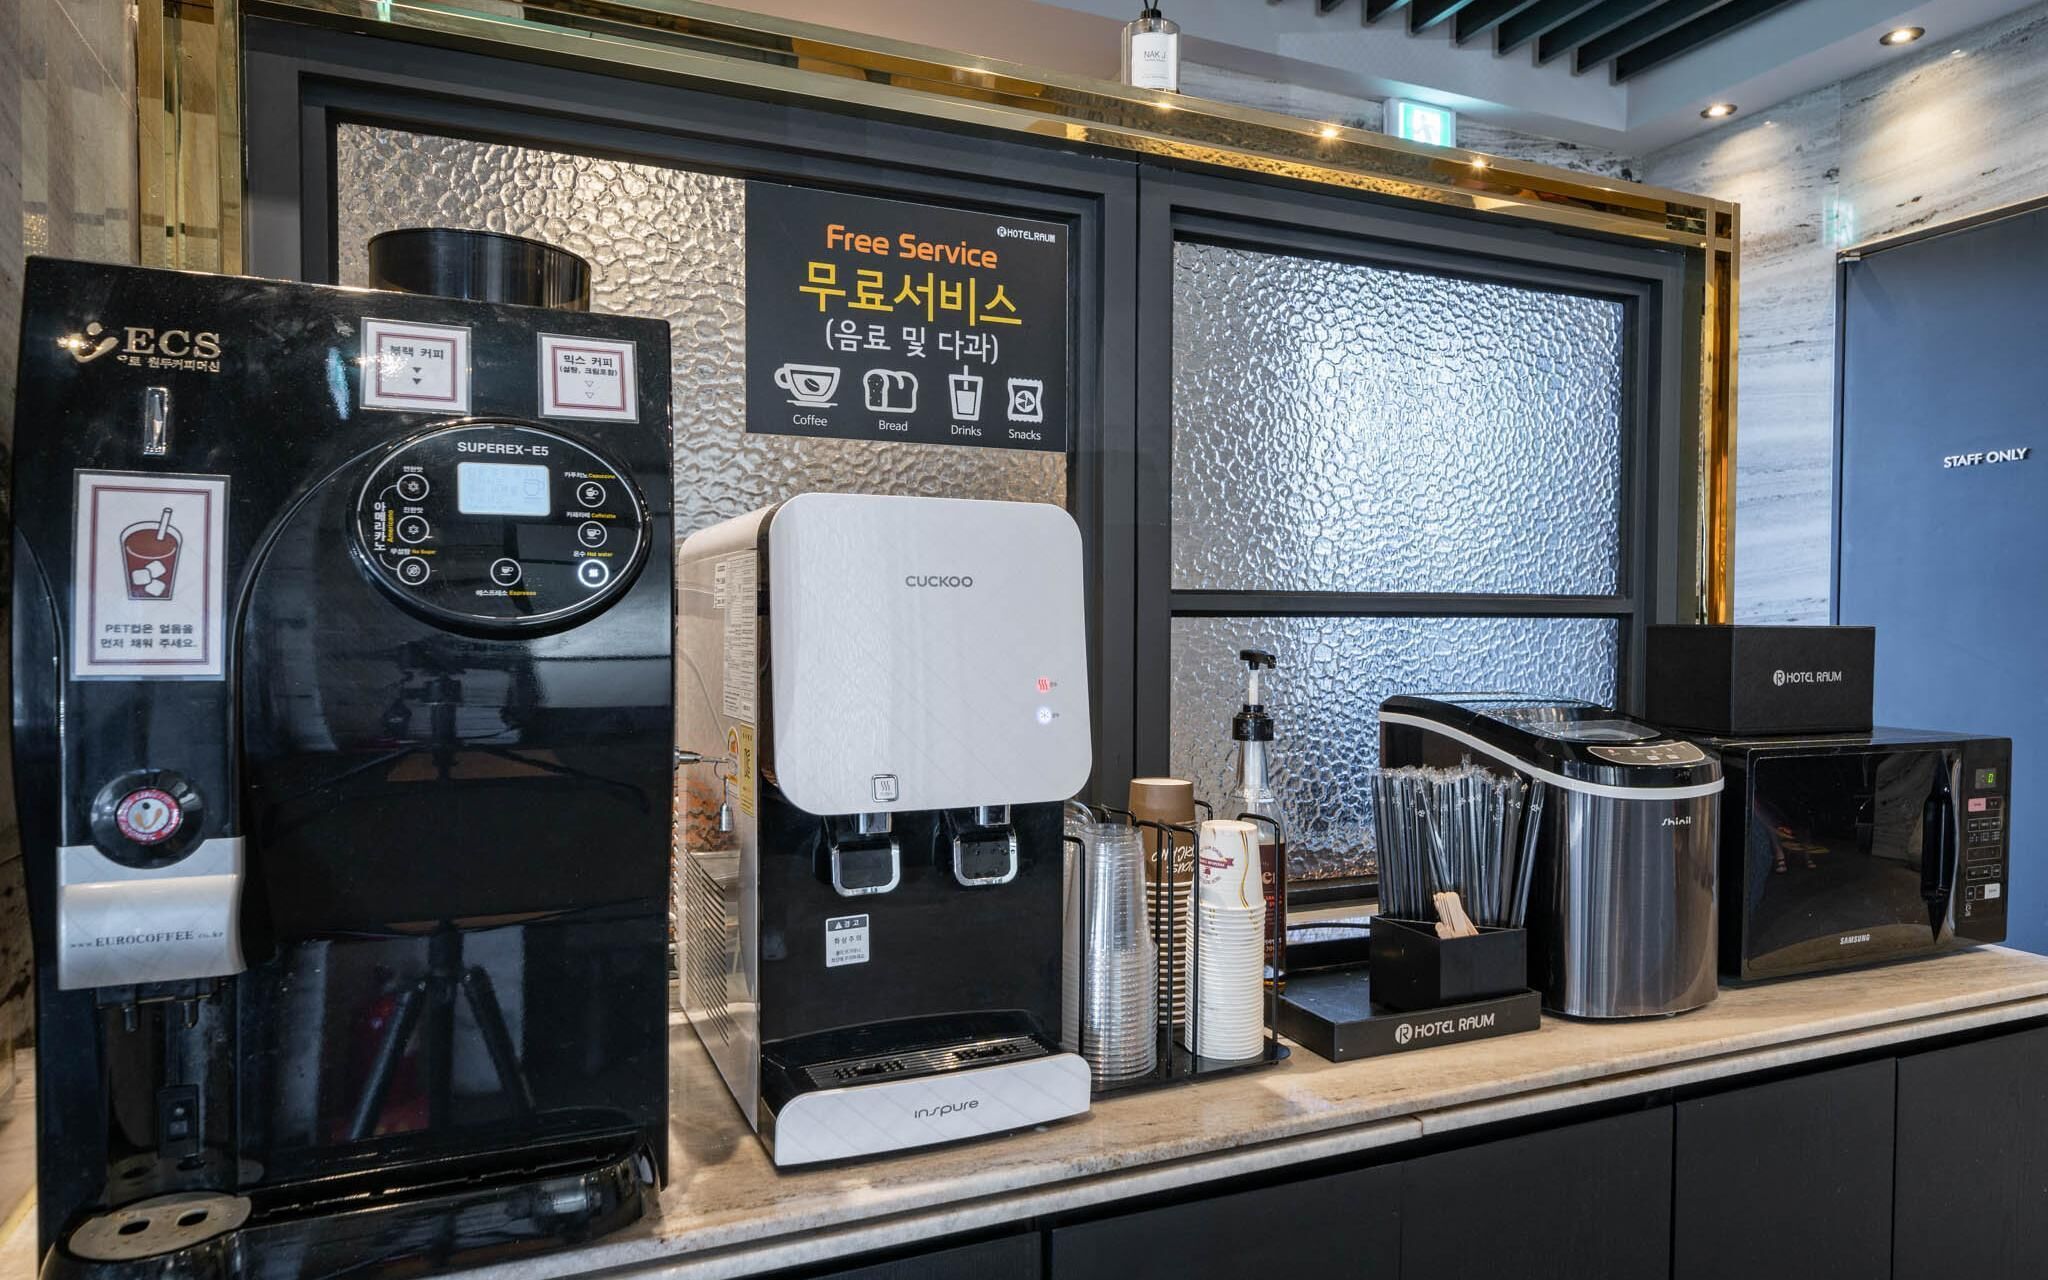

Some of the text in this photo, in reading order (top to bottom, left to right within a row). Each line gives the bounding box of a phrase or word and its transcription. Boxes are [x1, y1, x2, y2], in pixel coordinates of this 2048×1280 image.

[827, 223, 998, 269] Free Service
[799, 261, 1022, 327] 무료서비스
[122, 326, 222, 359] ECS
[826, 318, 999, 365] (음료 및 다과)
[420, 348, 444, 360] 커피
[563, 354, 612, 368] 믹스 커피
[793, 414, 828, 427] Coffee
[878, 419, 908, 432] Bread
[951, 424, 982, 437] Drinks
[1008, 428, 1041, 441] Snacks
[457, 441, 550, 456] SUPEREX-E5
[1944, 447, 2027, 469] STAFF ONLY
[373, 501, 387, 551] 아메리카노
[905, 575, 974, 588] CUCKOO
[104, 623, 193, 635] PET컵은 얼음을
[101, 638, 124, 649] 먼저
[130, 638, 153, 649] 채워
[1786, 671, 1815, 684] HOTEL
[1816, 671, 1842, 683] RAUM
[95, 930, 194, 948] EUROCOFFEE
[1840, 933, 1870, 945] SAMSUNG
[1414, 1020, 1454, 1039] HOTEL
[1458, 1012, 1495, 1032] RAUM
